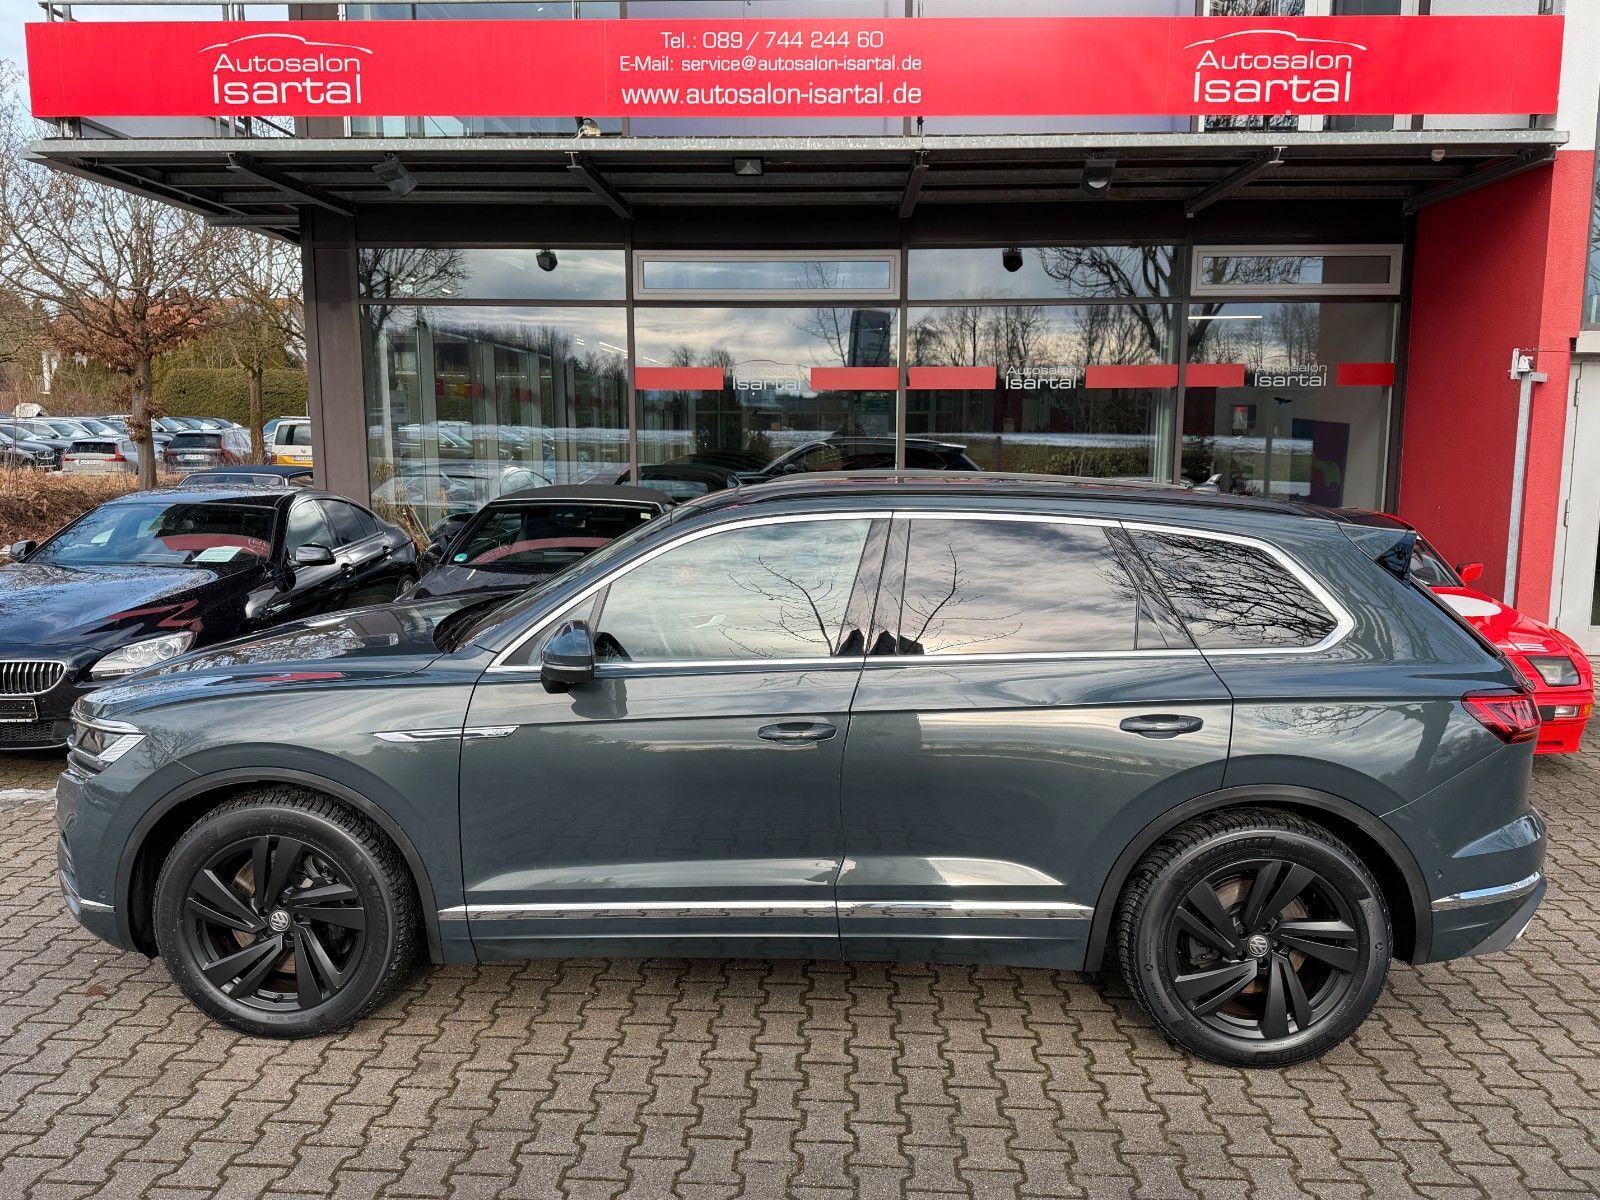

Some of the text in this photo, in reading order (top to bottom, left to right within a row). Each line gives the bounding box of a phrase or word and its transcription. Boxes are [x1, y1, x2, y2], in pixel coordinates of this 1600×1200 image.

[661, 31, 696, 49] Tel.:
[810, 31, 850, 49] 244
[857, 31, 884, 48] 60
[213, 53, 361, 73] Autosalon
[619, 54, 922, 71] E-Mail: service@autosalon-isartal.de
[1196, 49, 1352, 70] Autosalon
[212, 73, 362, 105] Isartal
[621, 81, 922, 105] www.autosalon-isartal.de
[1193, 70, 1352, 103] Isartal
[1006, 365, 1077, 376] Autosalon
[1254, 372, 1327, 387] Isartal
[732, 376, 802, 391] Isartal
[1005, 374, 1077, 390] Isartal
